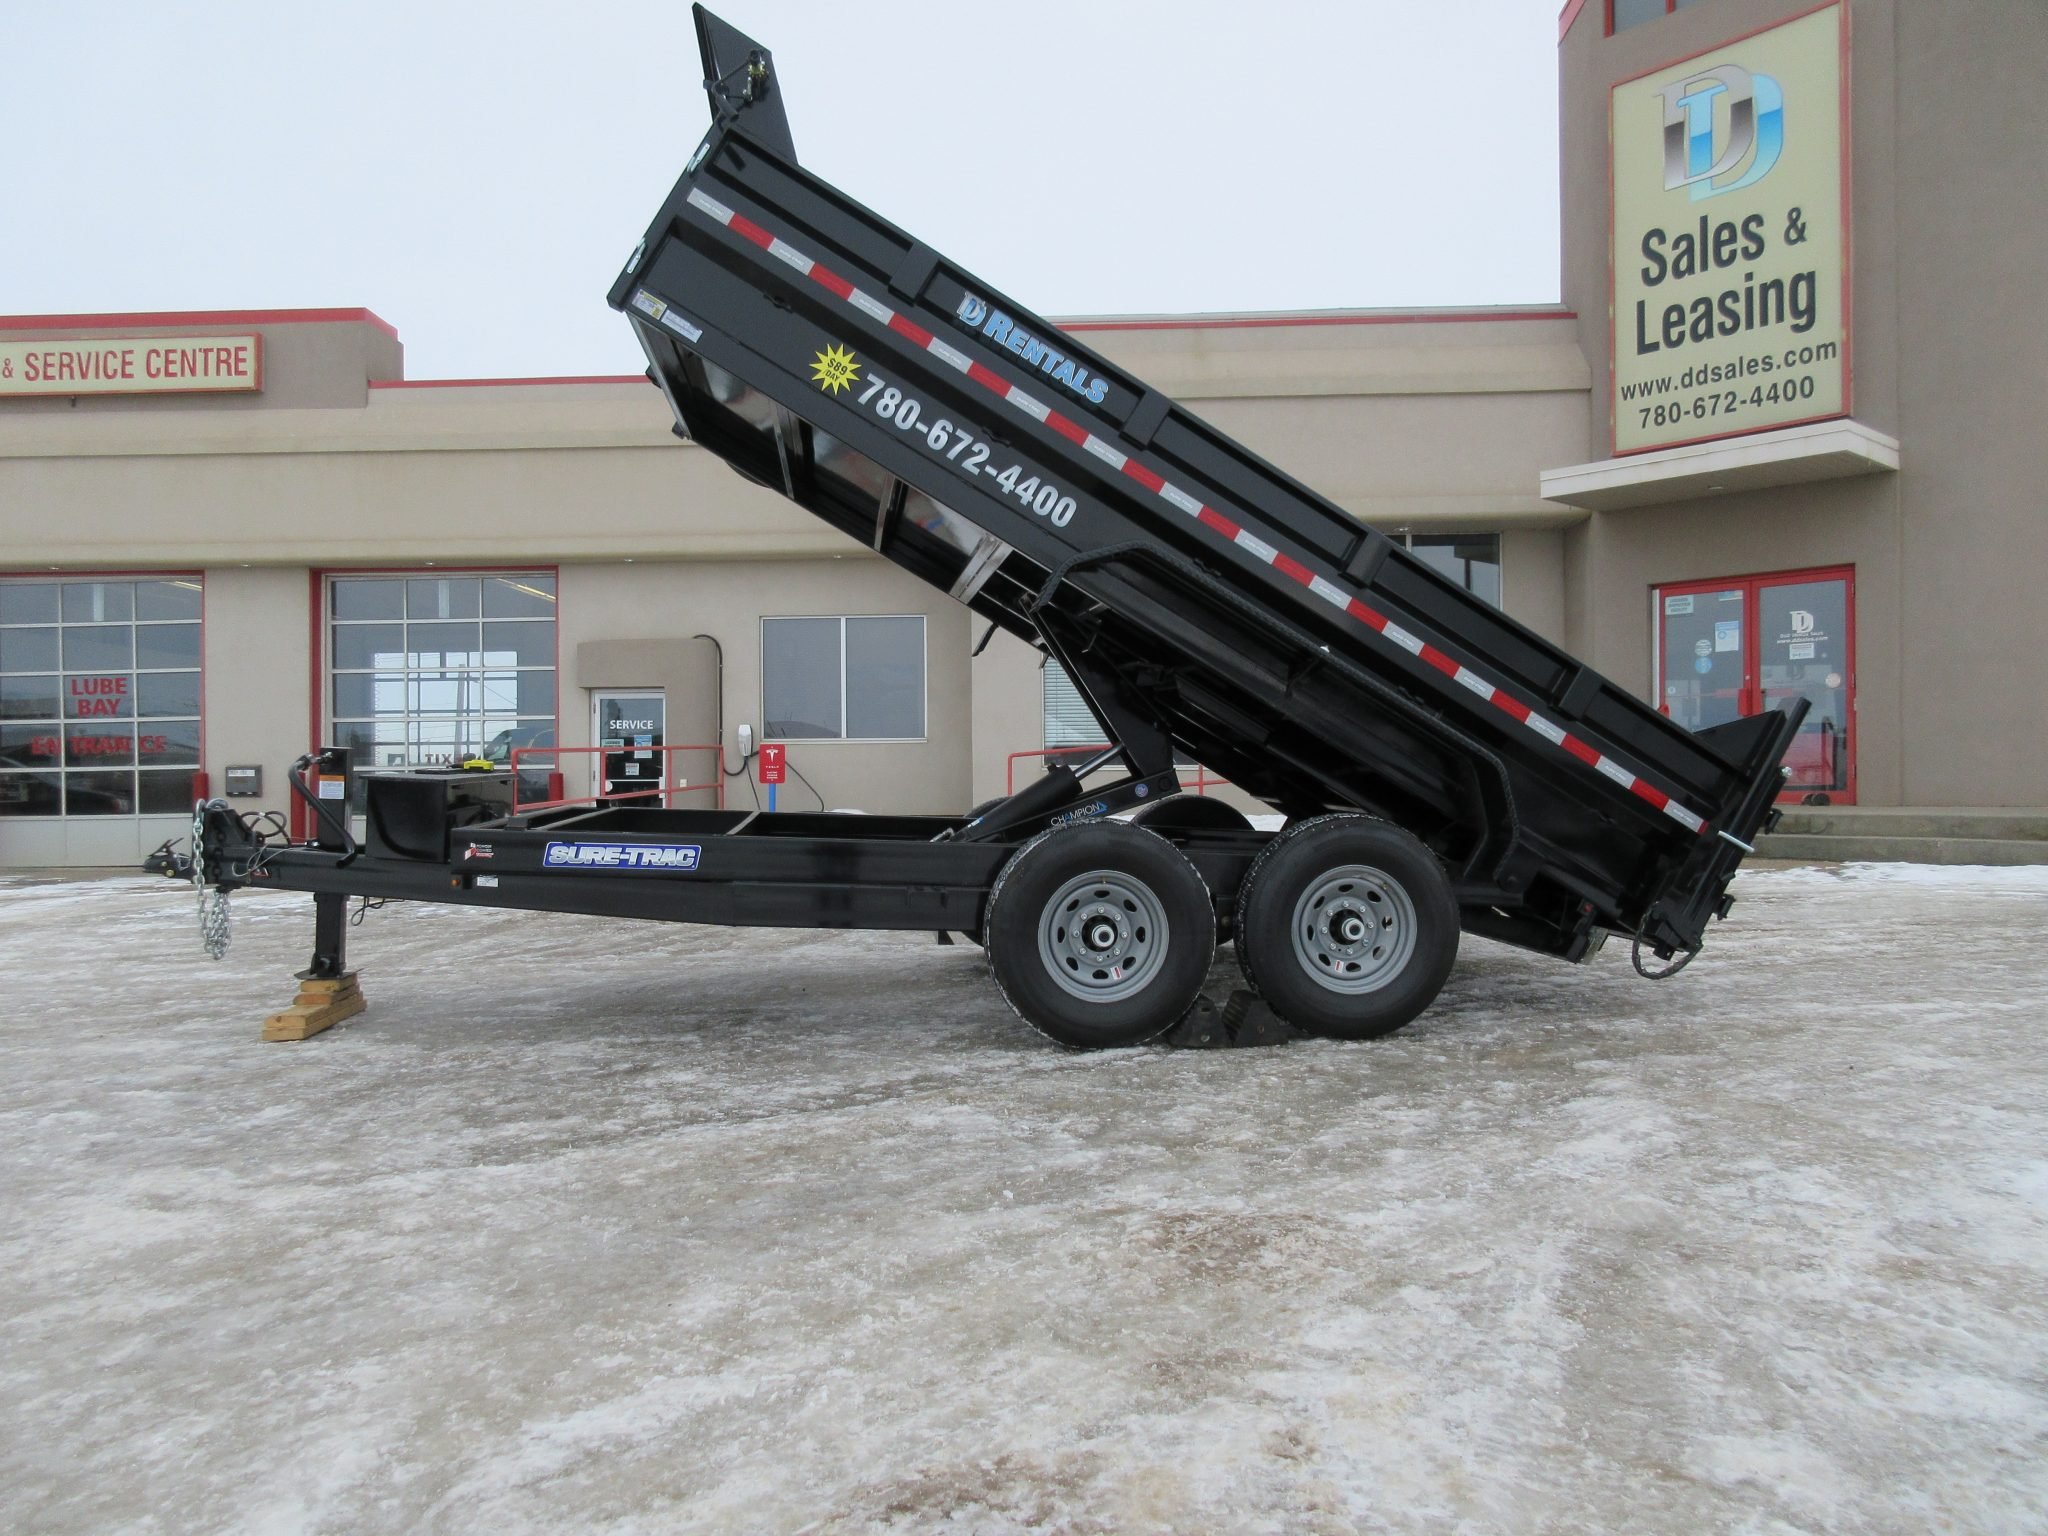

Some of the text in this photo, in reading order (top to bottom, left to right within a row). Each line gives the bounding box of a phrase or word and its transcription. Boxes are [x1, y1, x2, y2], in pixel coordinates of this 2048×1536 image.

[1641, 207, 1807, 287] Sales &
[1636, 270, 1816, 355] Leasing
[2, 346, 248, 382] & SERVICE CENTRE
[982, 308, 1109, 403] RENTALS
[1621, 341, 1837, 401] www.ddsales.com
[1639, 375, 1815, 429] 780-672-4400
[857, 373, 1077, 528] 780-672-4400
[71, 677, 128, 696] LUBE
[77, 698, 122, 717] BAY
[609, 719, 654, 730] SERVICE
[1051, 802, 1100, 826] CHAMPION
[549, 846, 696, 867] SURE-TRAC
